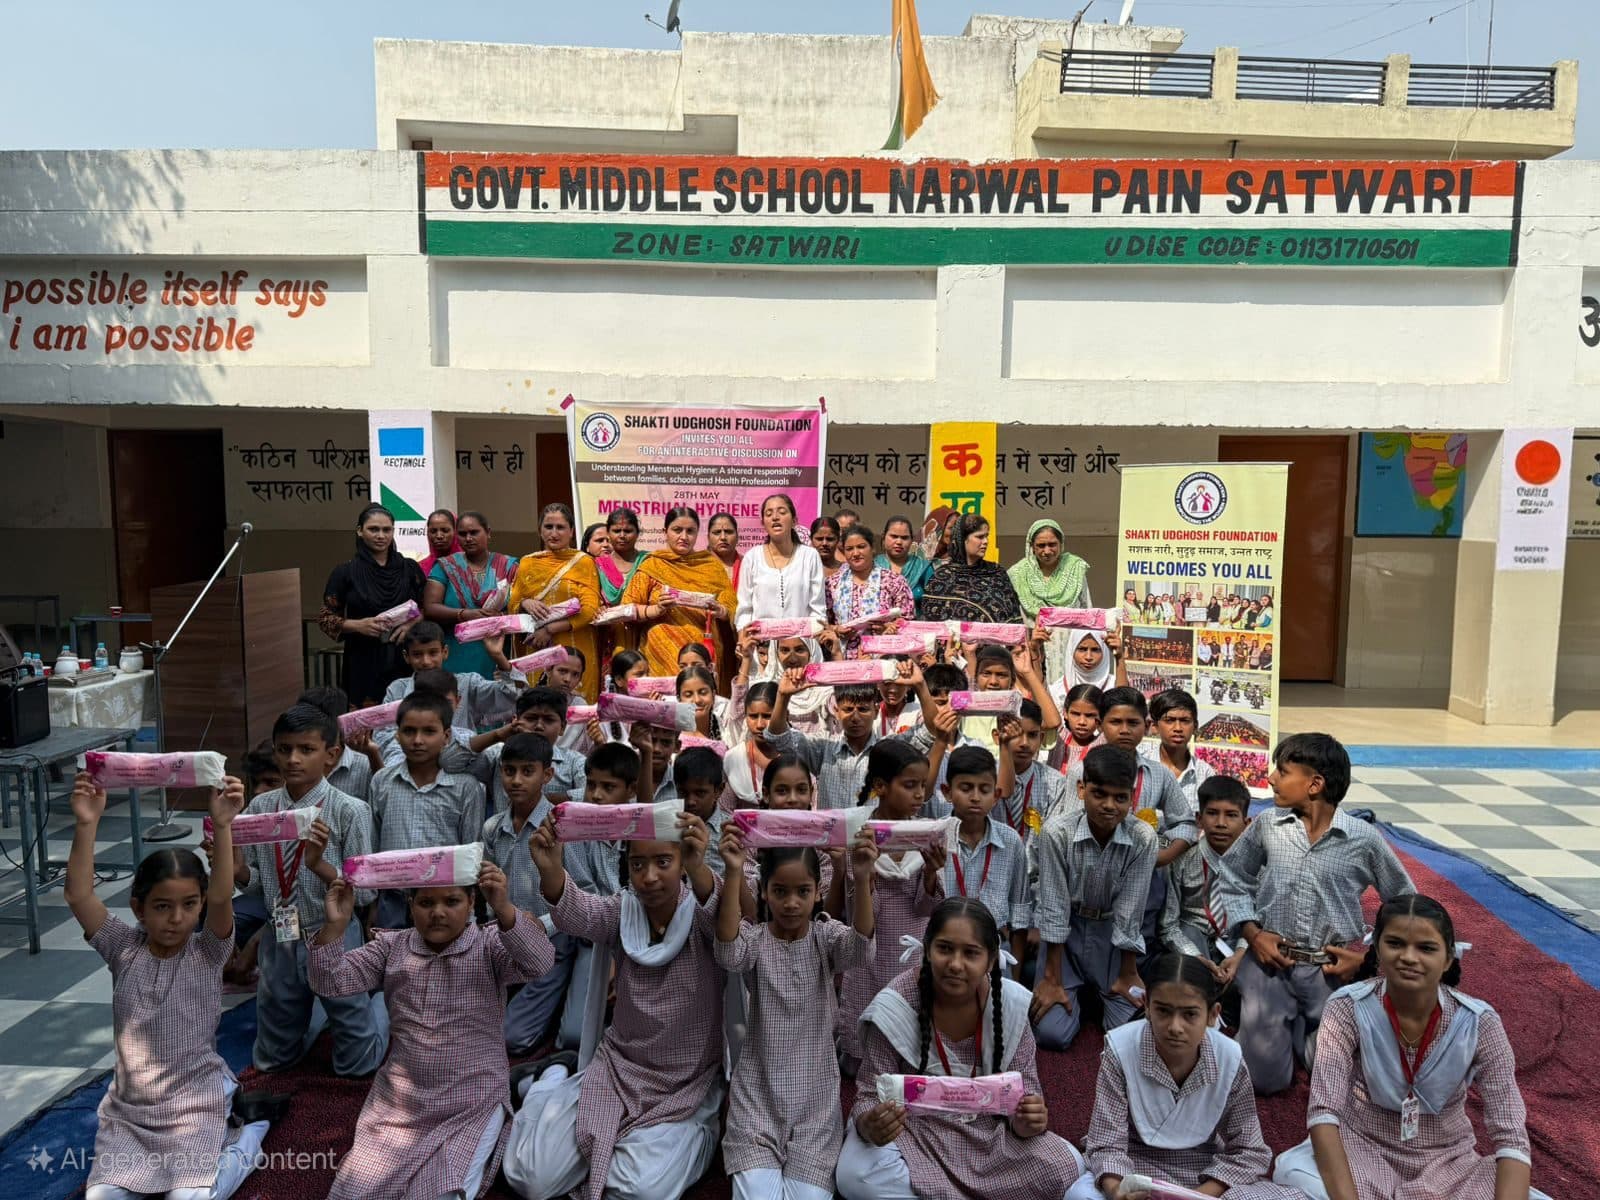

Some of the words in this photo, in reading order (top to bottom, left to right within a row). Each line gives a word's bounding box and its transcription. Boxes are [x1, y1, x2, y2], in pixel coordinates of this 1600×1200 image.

[449, 164, 549, 210] GOVT.
[559, 166, 702, 212] MIDDLE
[713, 166, 875, 214] SCHOOL
[888, 167, 1070, 214] NARWAL
[1092, 168, 1203, 214] PAIN
[1225, 168, 1472, 214] SATWARI
[728, 235, 860, 260] SATWARI
[1280, 237, 1420, 260] 01131710501
[2, 270, 148, 313] possible
[161, 270, 249, 307] itself
[255, 277, 329, 318] says
[9, 316, 22, 350] i
[33, 323, 88, 351] am
[105, 317, 256, 354] possible
[624, 415, 669, 428] SHAKTI
[673, 416, 731, 430] UDGHOSH
[735, 417, 812, 431] FOUNDATION
[681, 434, 716, 444] INVITES
[719, 435, 736, 444] YOU
[739, 436, 754, 445] ALL
[383, 457, 427, 468] RECTANGLE
[503, 443, 524, 474] ही
[638, 446, 655, 456] FOR
[656, 446, 671, 456] AN
[672, 446, 729, 457] INTERACTIVE
[732, 448, 784, 458] DISCUSSION
[786, 449, 798, 458] ON
[875, 448, 900, 473] को
[941, 443, 983, 477] क
[1038, 447, 1077, 475] रखो
[1084, 445, 1121, 474] और
[591, 463, 646, 474] Understanding
[647, 464, 685, 473] Menstrual
[727, 467, 753, 475] shared
[754, 467, 802, 477] responsibility
[715, 477, 738, 485] Health
[741, 477, 790, 485] Professionals
[246, 480, 334, 504] सफलता
[674, 491, 697, 499] 28TH
[700, 491, 720, 499] MAY
[823, 480, 865, 508] दिशा
[695, 502, 760, 517] HYGIENE
[398, 527, 426, 537] TRIANGL
[1125, 529, 1160, 540] SHAKTI
[1162, 530, 1210, 541] UDGHOSH
[1213, 531, 1278, 542] FOUNDATION
[1127, 561, 1207, 577] WELCOMES
[1212, 563, 1242, 578] YOU
[1246, 564, 1273, 580] ALL
